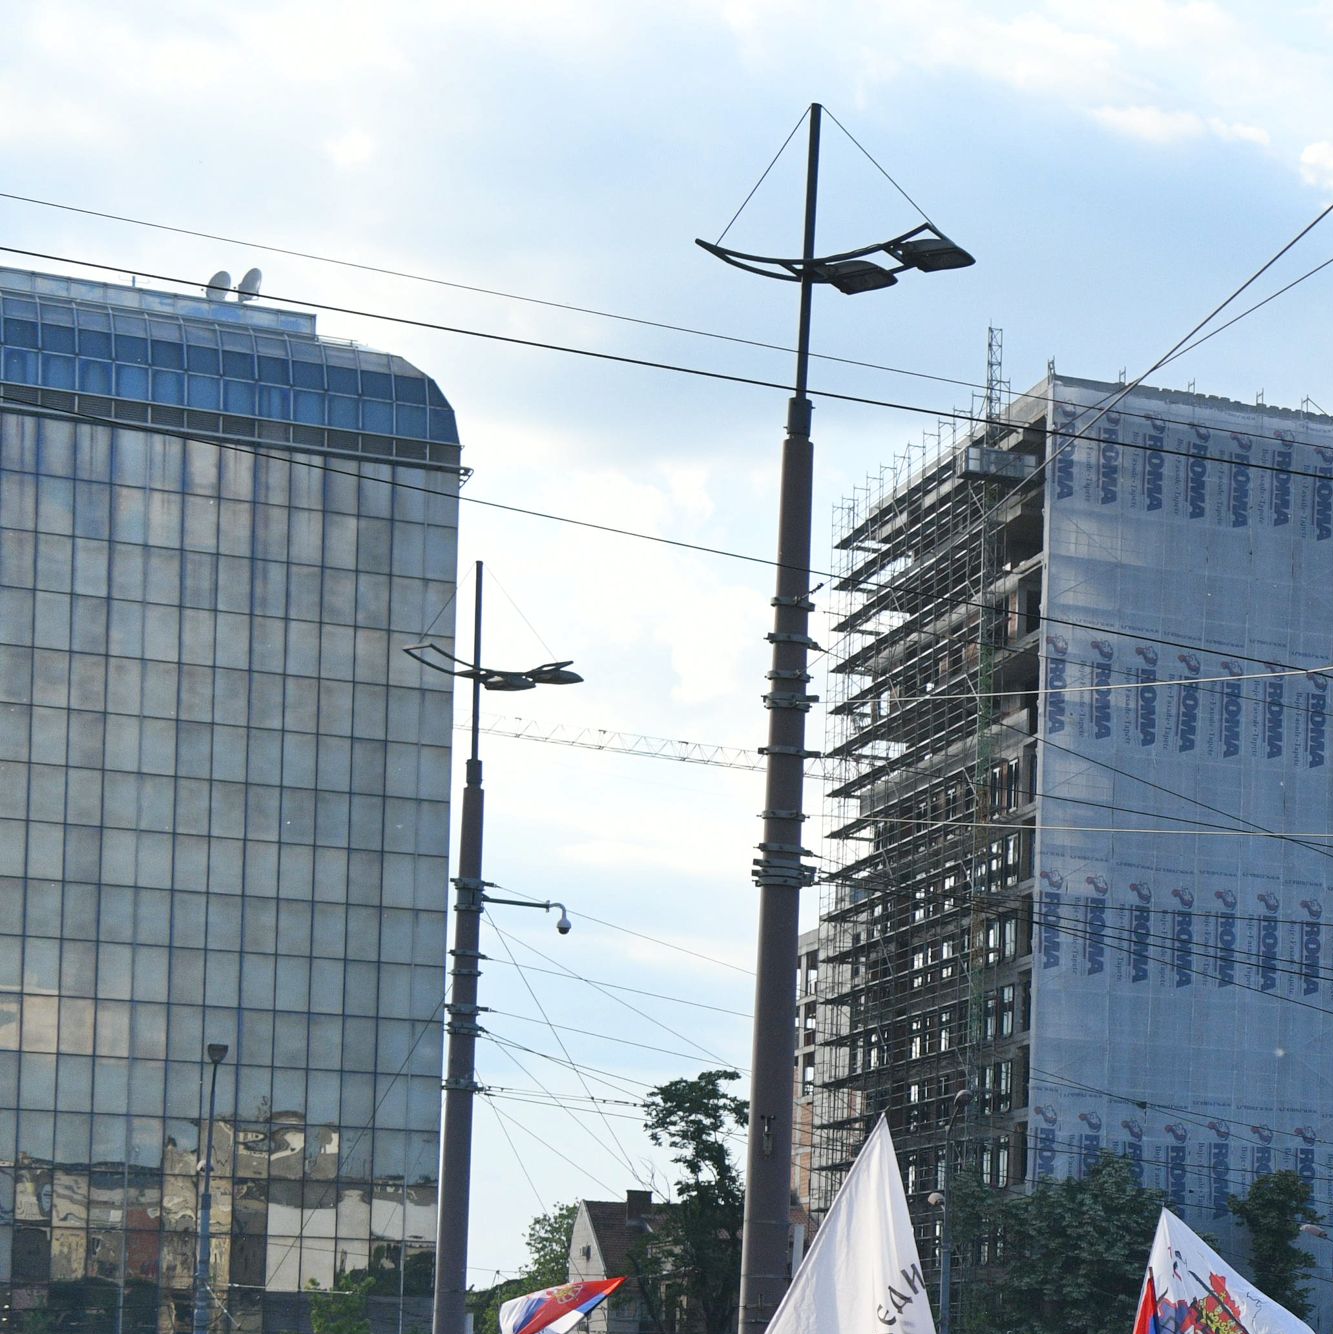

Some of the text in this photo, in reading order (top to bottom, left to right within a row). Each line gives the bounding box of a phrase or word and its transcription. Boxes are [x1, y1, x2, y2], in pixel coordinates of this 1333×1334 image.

[1101, 428, 1119, 504] ROMA
[1147, 434, 1164, 511] ROMA
[1190, 441, 1208, 519] ROMA
[1233, 453, 1251, 527] ROMA
[1274, 451, 1292, 526] ROMA
[1317, 467, 1333, 541] ROMA
[1049, 659, 1066, 734] ROMA
[1095, 663, 1111, 739] ROMA
[1140, 669, 1156, 746] ROMA
[1179, 676, 1200, 752] ROMA
[1223, 682, 1241, 758] ROMA
[1267, 682, 1284, 759] ROMA
[1309, 694, 1326, 768] ROMA
[1043, 892, 1060, 969] ROMA
[1087, 897, 1105, 975] ROMA
[1132, 906, 1150, 983] ROMA
[1176, 911, 1193, 988] ROMA
[1218, 913, 1235, 987] ROMA
[1261, 915, 1278, 990] ROMA
[1304, 921, 1321, 995] ROMA
[1213, 1143, 1229, 1219] ROMA
